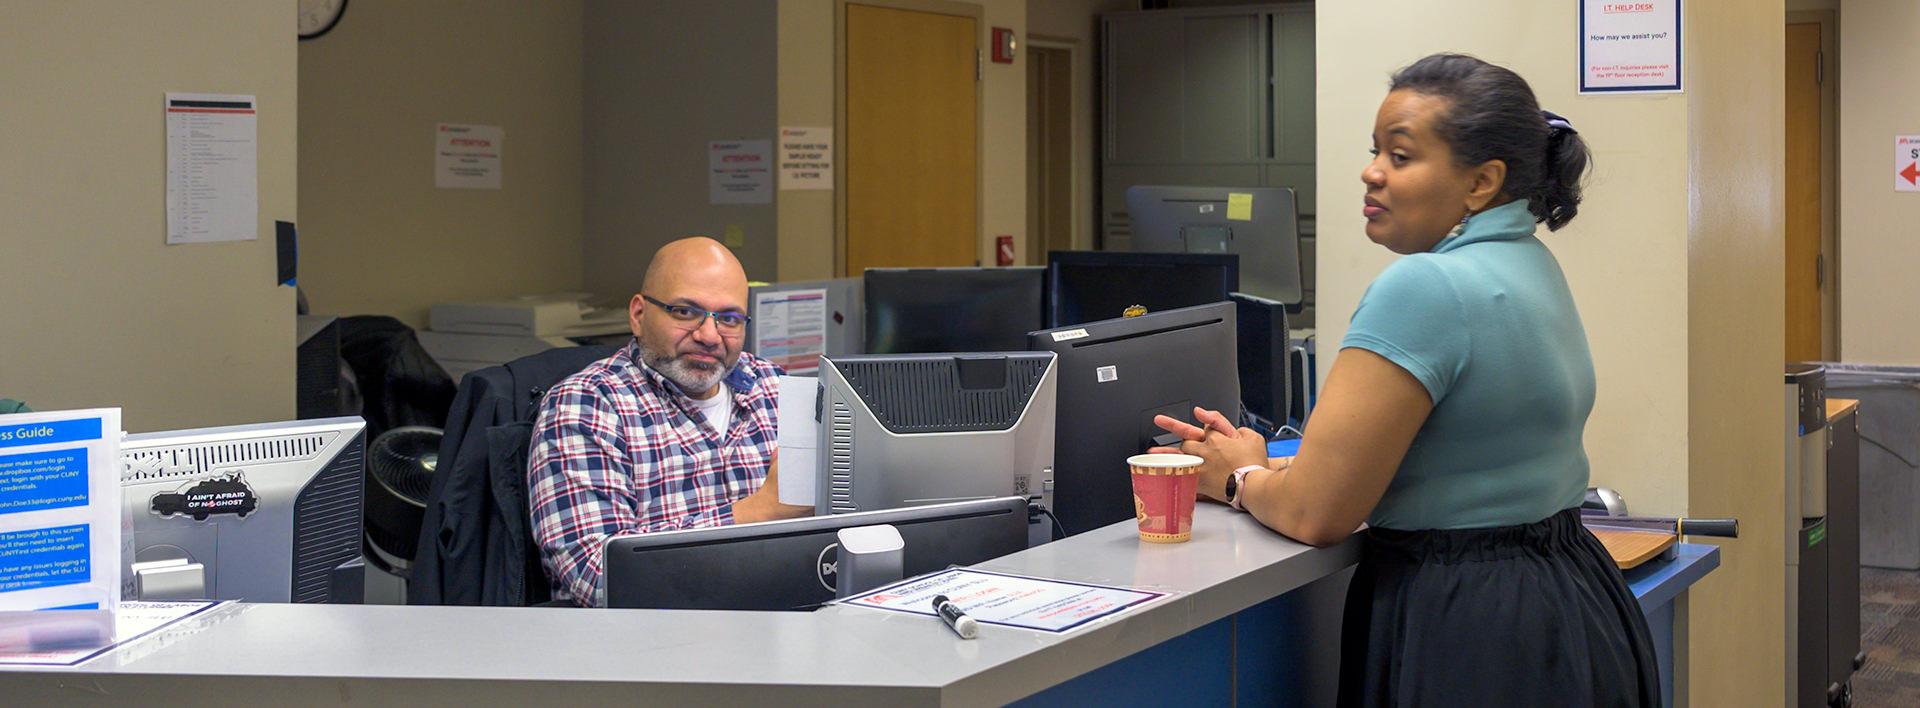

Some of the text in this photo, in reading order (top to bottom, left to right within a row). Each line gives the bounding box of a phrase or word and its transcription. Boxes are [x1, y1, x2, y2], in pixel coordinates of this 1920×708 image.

[1651, 32, 1667, 40] you?
[1911, 148, 1920, 159] S
[16, 426, 54, 439] Guide
[215, 491, 246, 500] AFRAID
[215, 499, 244, 507] GHOST
[30, 545, 65, 553] credentials
[54, 559, 79, 567] logging
